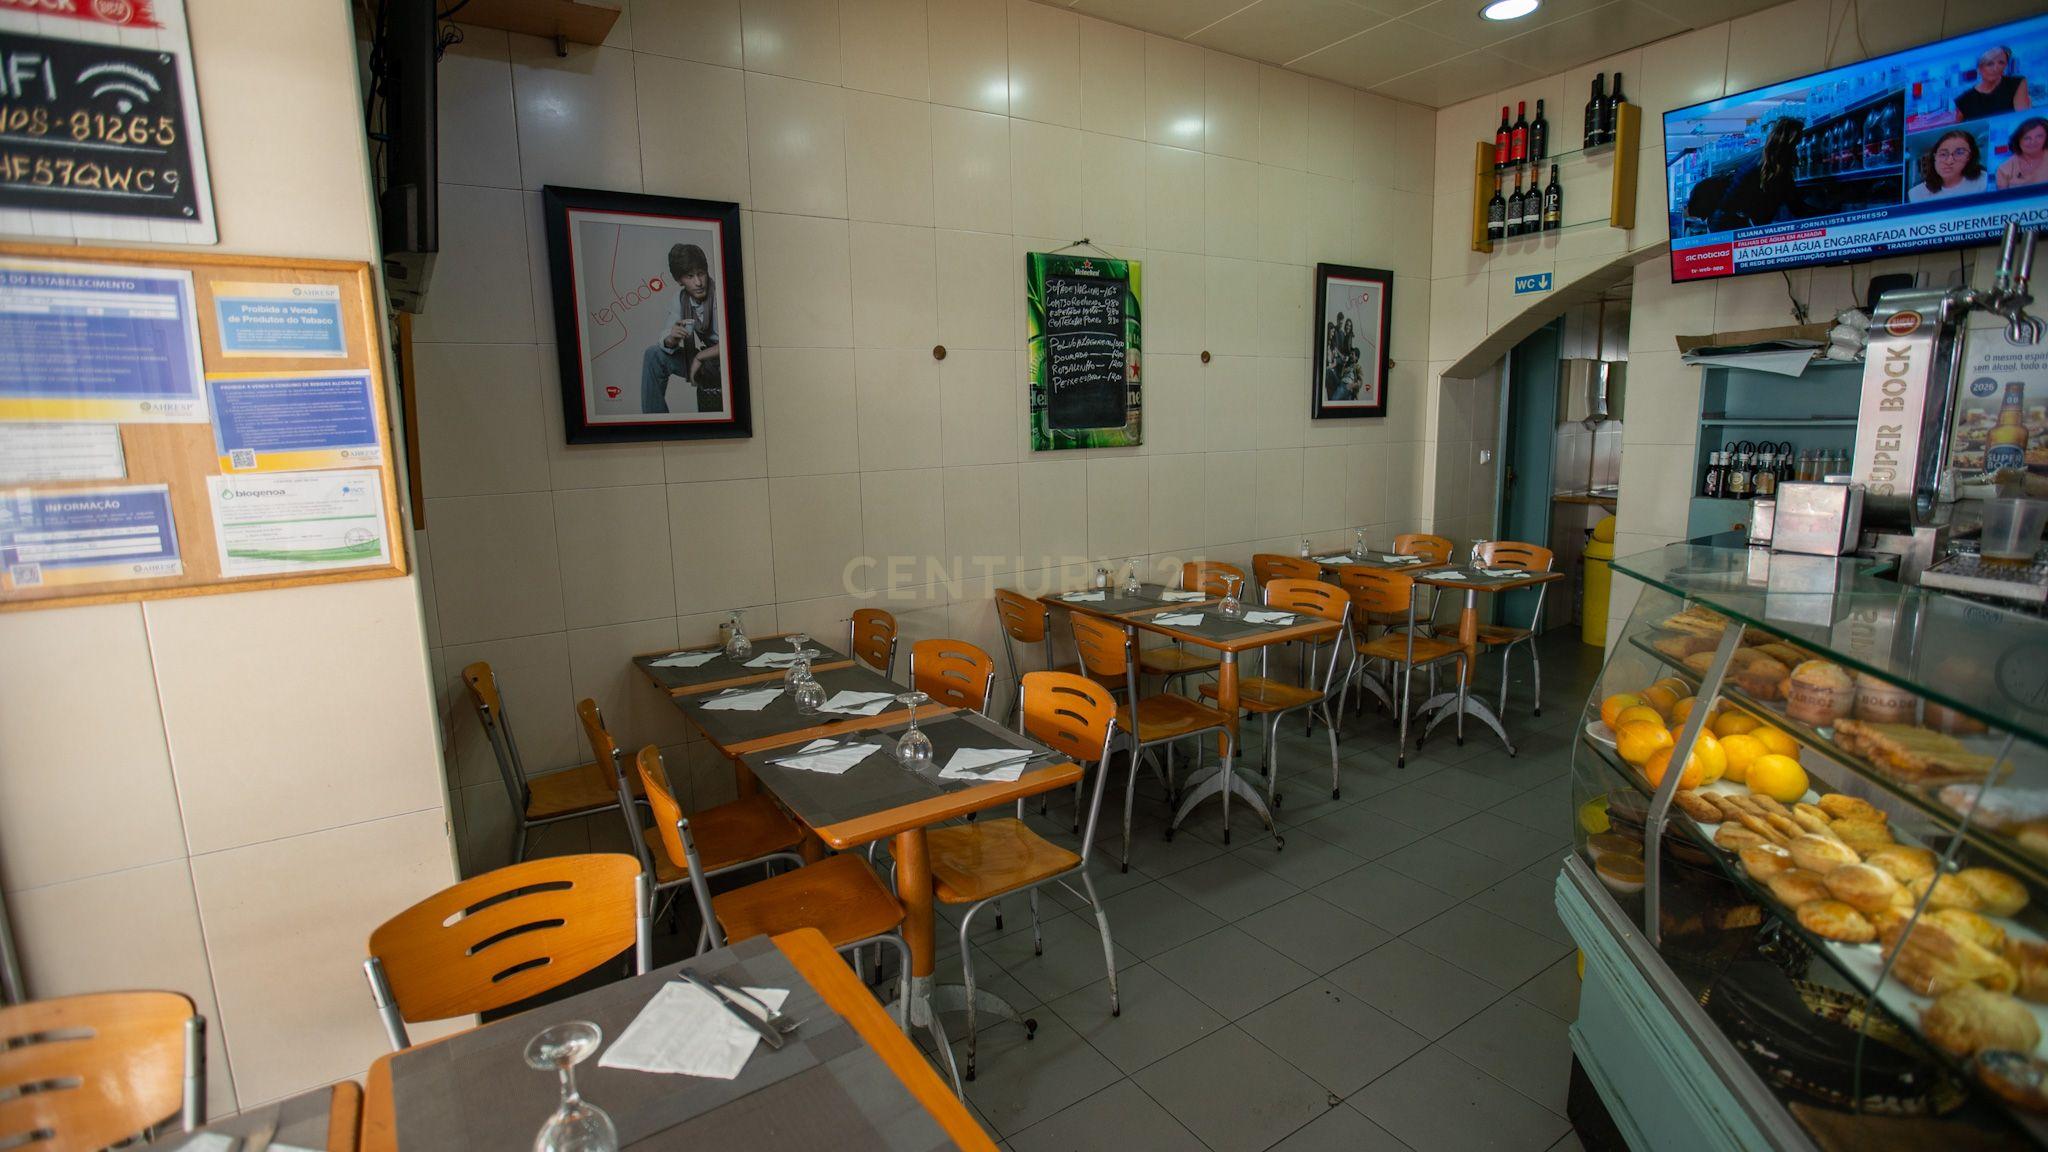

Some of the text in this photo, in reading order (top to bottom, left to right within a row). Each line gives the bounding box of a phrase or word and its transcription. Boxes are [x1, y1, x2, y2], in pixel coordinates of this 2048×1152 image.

[1737, 211, 1888, 239] LILIANA VALENTE JORNALISTA EXPRESSO
[1737, 239, 1760, 248] FALHAS
[1769, 234, 1785, 244] ÁGUA
[1797, 230, 1823, 239] ALMADA
[1737, 246, 1750, 260] JÁ
[1751, 244, 1773, 258] NÃO
[1776, 242, 1790, 255] HÁ
[1791, 237, 1822, 253] ÁGUA
[1823, 228, 1907, 249] ENGARRAFADA
[1909, 223, 1936, 237] NOS
[1776, 251, 1826, 264] PROSTITUIÇÃO
[1838, 246, 1873, 257] ESPANHA
[1887, 236, 1943, 251] TRANSPORTES
[1944, 229, 1987, 243] PÚBLICOS
[30, 276, 135, 291] ESTABELECIMENTO
[1516, 279, 1535, 289] WC
[241, 304, 280, 315] Proibida
[289, 306, 318, 315] Venda
[228, 315, 240, 323] de
[242, 315, 285, 325] Produtos
[301, 316, 333, 326] Tabaco
[1984, 353, 1991, 362] O
[1993, 353, 2023, 362] mesmo
[1973, 364, 1991, 372] sem
[2020, 362, 2041, 370] todo
[1879, 344, 1912, 413] BOCK
[1972, 382, 1996, 393] 2026
[1869, 424, 1903, 497] SUPER
[1986, 451, 2022, 463] SUPER
[235, 489, 286, 499] biogenoa
[44, 499, 121, 513] INFORMAÇÃO
